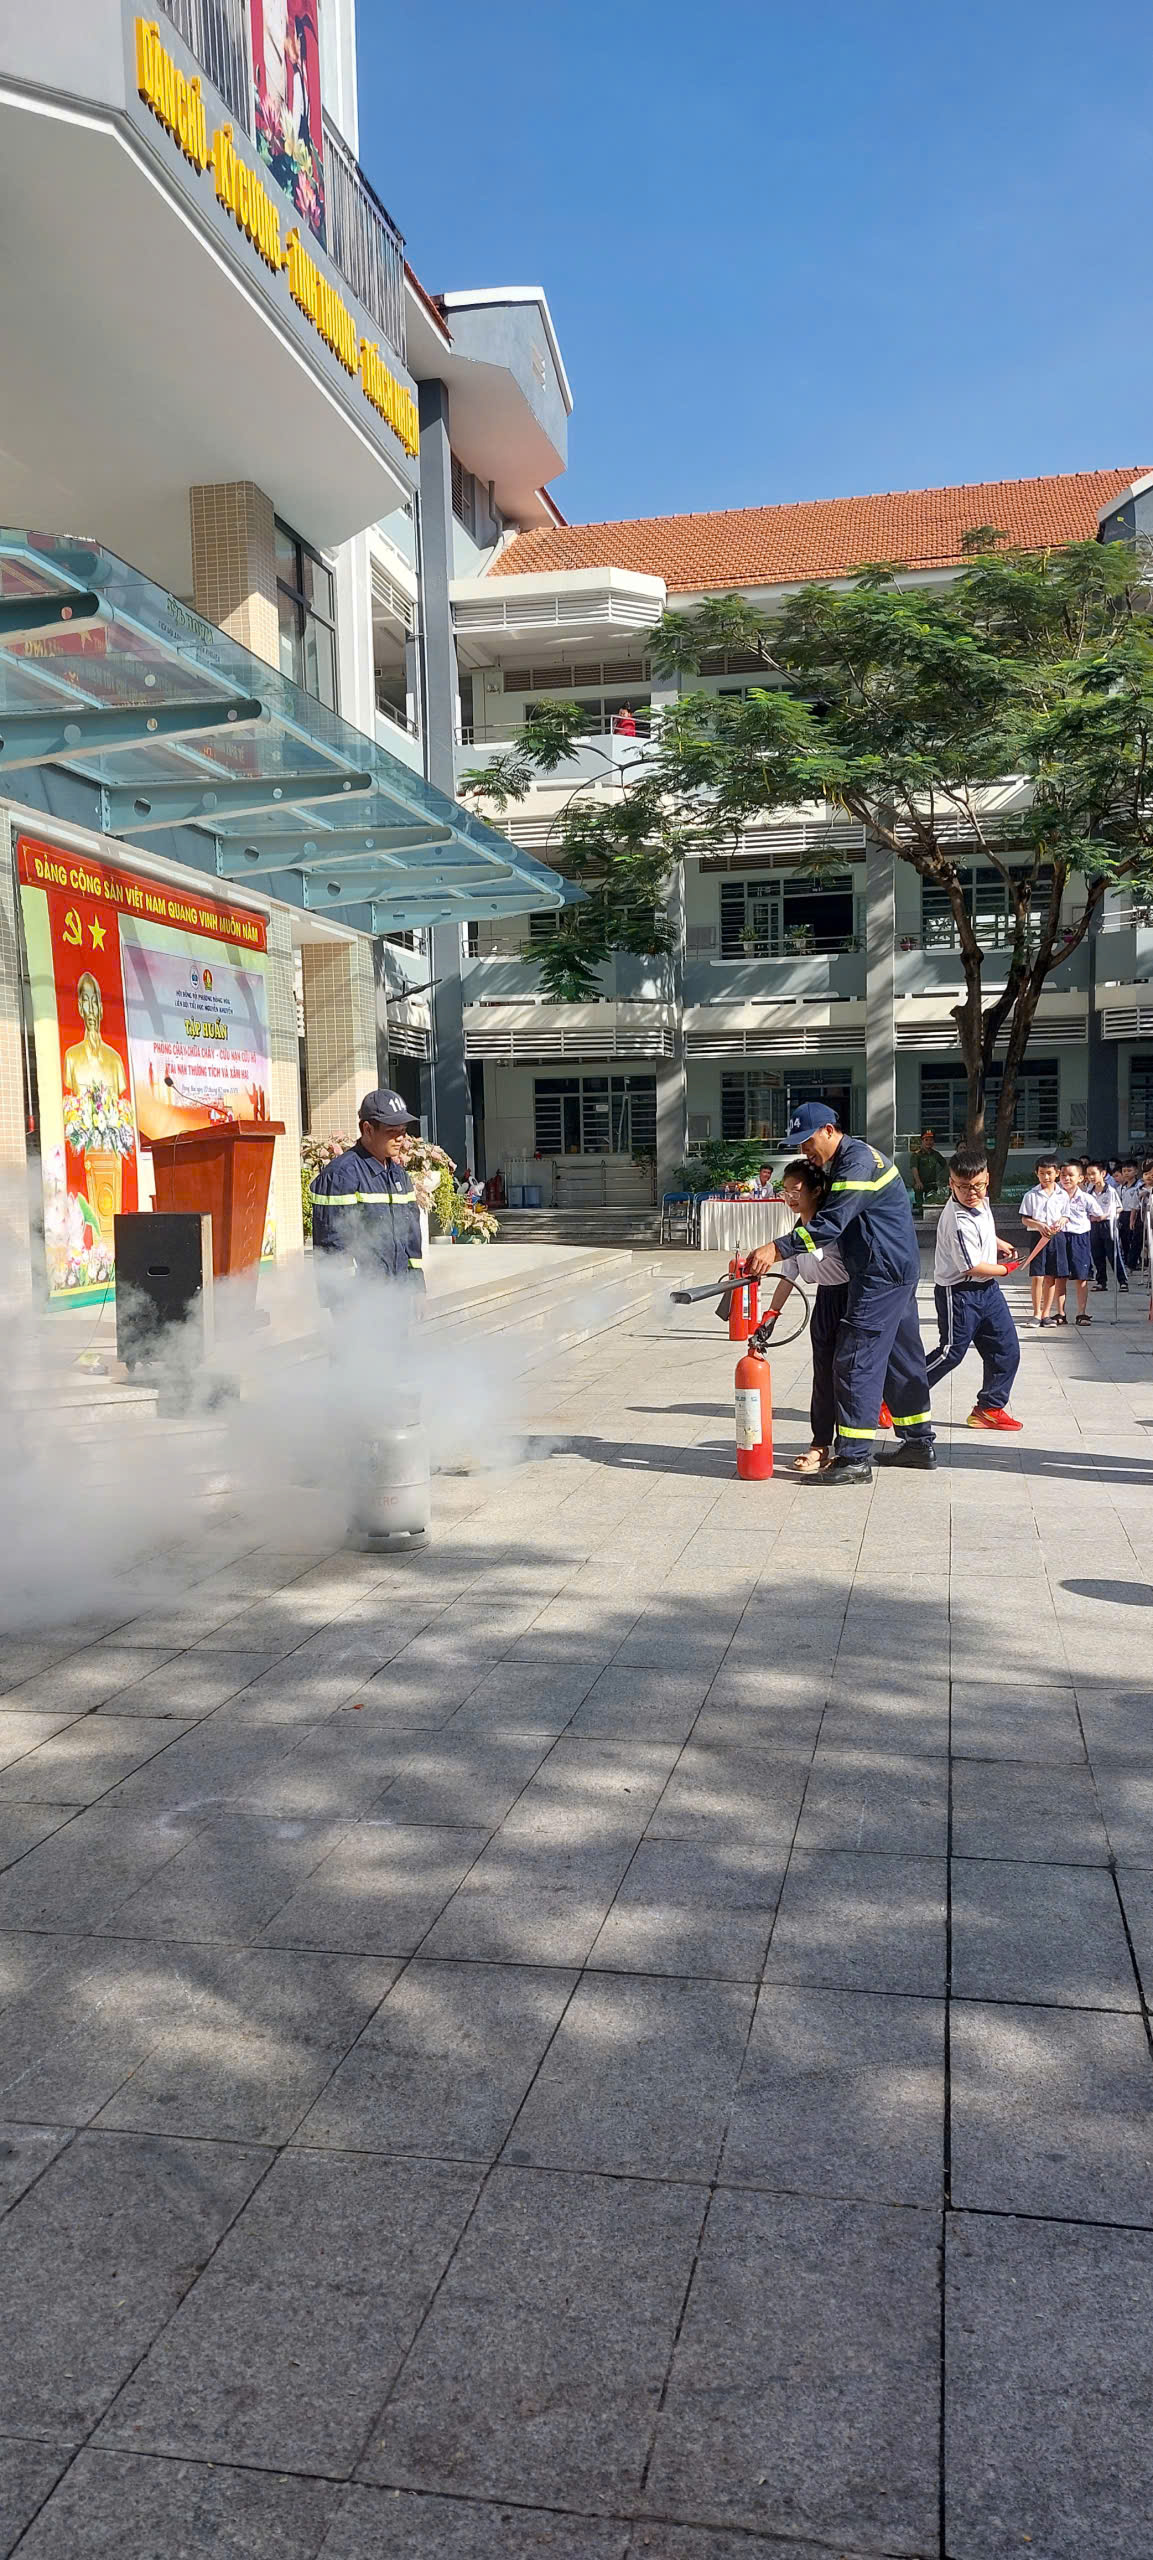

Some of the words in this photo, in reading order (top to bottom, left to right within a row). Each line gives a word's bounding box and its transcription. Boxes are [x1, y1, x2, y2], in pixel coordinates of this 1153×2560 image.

[34, 855, 67, 886] ĐẢNG
[70, 867, 102, 897] CỘNG
[103, 877, 124, 904] SẢN
[125, 885, 144, 913] VIỆT
[145, 893, 167, 916] NAM
[167, 901, 198, 925] QUANG
[199, 910, 218, 931] VINH
[219, 916, 241, 938] MUÔN
[242, 922, 259, 943] NĂM
[184, 1016, 202, 1040] TẬP
[202, 1017, 229, 1041] HUẤN
[207, 1064, 220, 1078] TÍCH
[221, 1066, 229, 1079] VÀ
